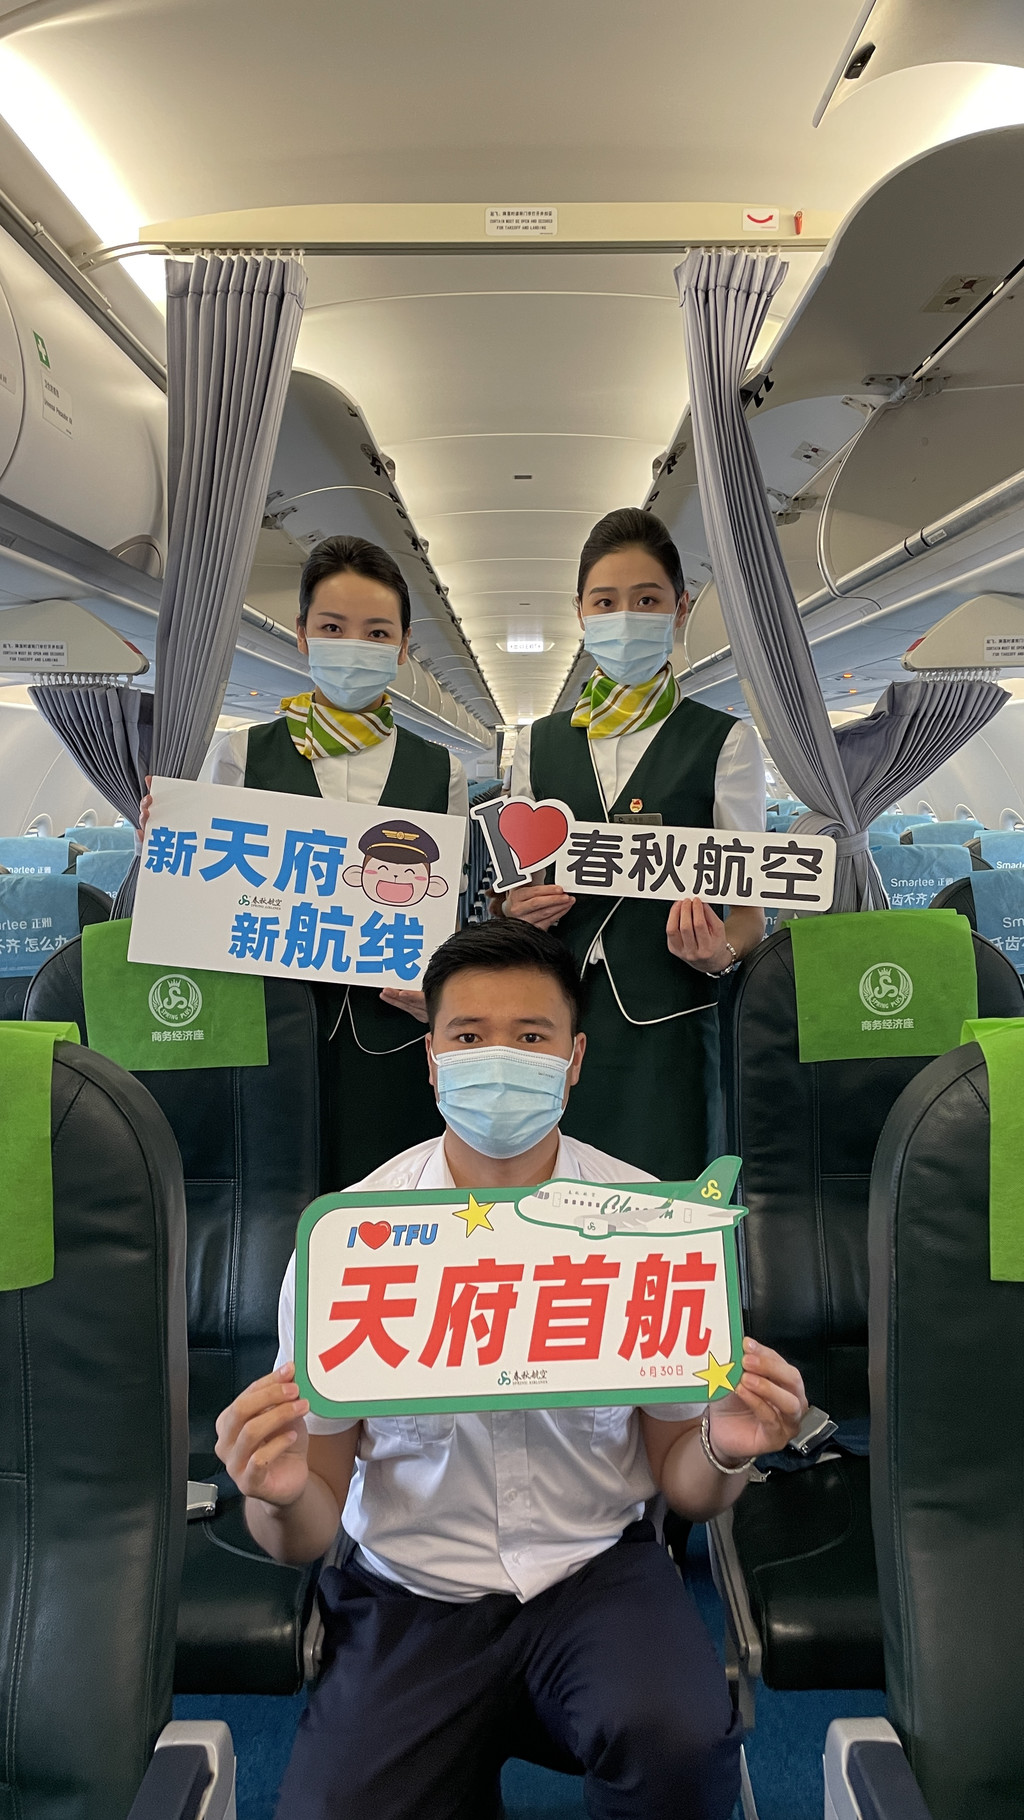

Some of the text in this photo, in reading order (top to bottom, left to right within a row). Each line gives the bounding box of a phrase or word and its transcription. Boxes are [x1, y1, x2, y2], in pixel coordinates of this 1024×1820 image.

[144, 817, 348, 897] 新天府
[567, 829, 823, 902] 春秋航空
[7, 866, 35, 874] marlee
[890, 878, 934, 887] Smarlee
[31, 917, 52, 929] 正雅
[228, 902, 424, 981] 新航线
[861, 1018, 914, 1031] 商务经济座
[151, 1029, 205, 1042] 商务经济座
[347, 1223, 438, 1248] I TFU
[318, 1251, 717, 1373] 天府首航
